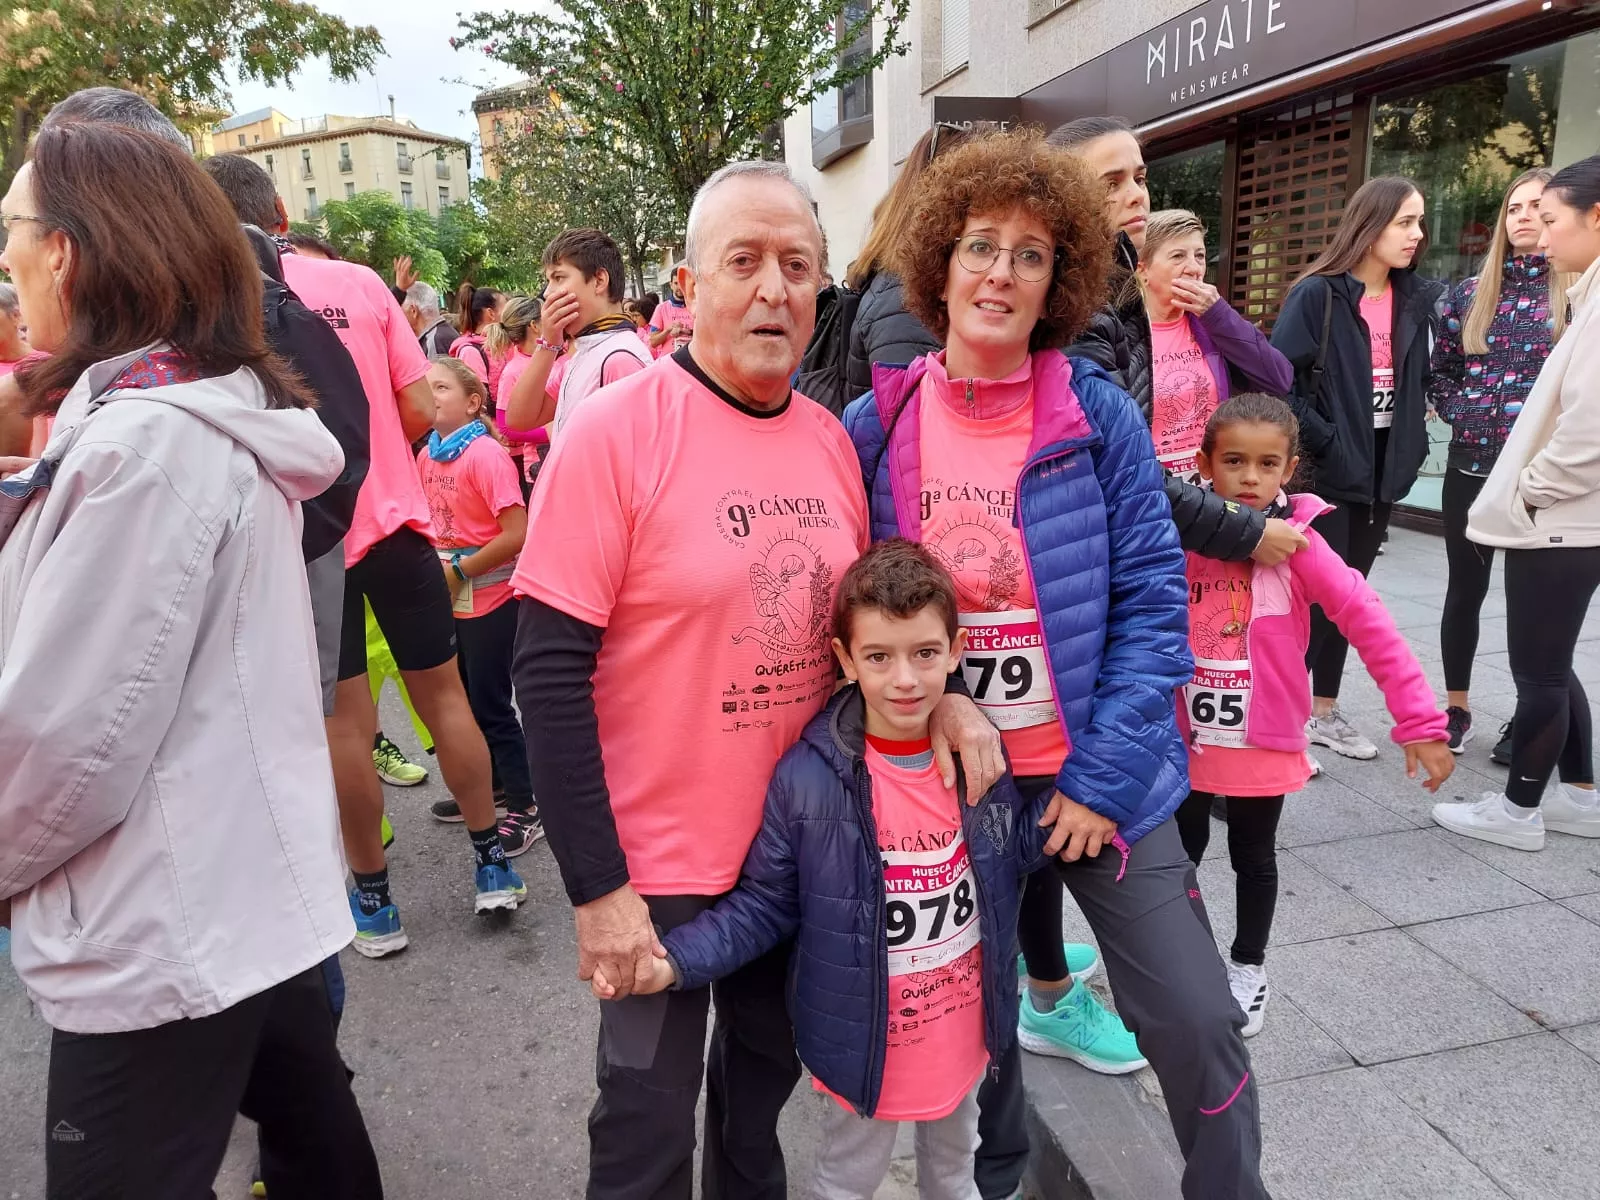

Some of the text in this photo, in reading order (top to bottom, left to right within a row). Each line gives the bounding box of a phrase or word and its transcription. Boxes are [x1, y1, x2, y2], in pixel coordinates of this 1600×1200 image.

[1147, 0, 1286, 84] MIRATE
[1170, 63, 1249, 103] MENSWEAR
[759, 495, 828, 516] CÁNCER
[798, 516, 841, 530] HUESCA
[1214, 576, 1252, 593] CÁN
[973, 638, 988, 650] EL
[755, 658, 807, 677] QUIÉRETE
[1203, 670, 1236, 679] HUESCA
[965, 655, 1033, 701] 79
[1213, 679, 1227, 689] EL
[1186, 691, 1244, 727] 65
[912, 863, 951, 877] HUESCA
[927, 877, 943, 890] EL
[886, 879, 974, 947] 978
[901, 976, 954, 998] QUIÉRETE
